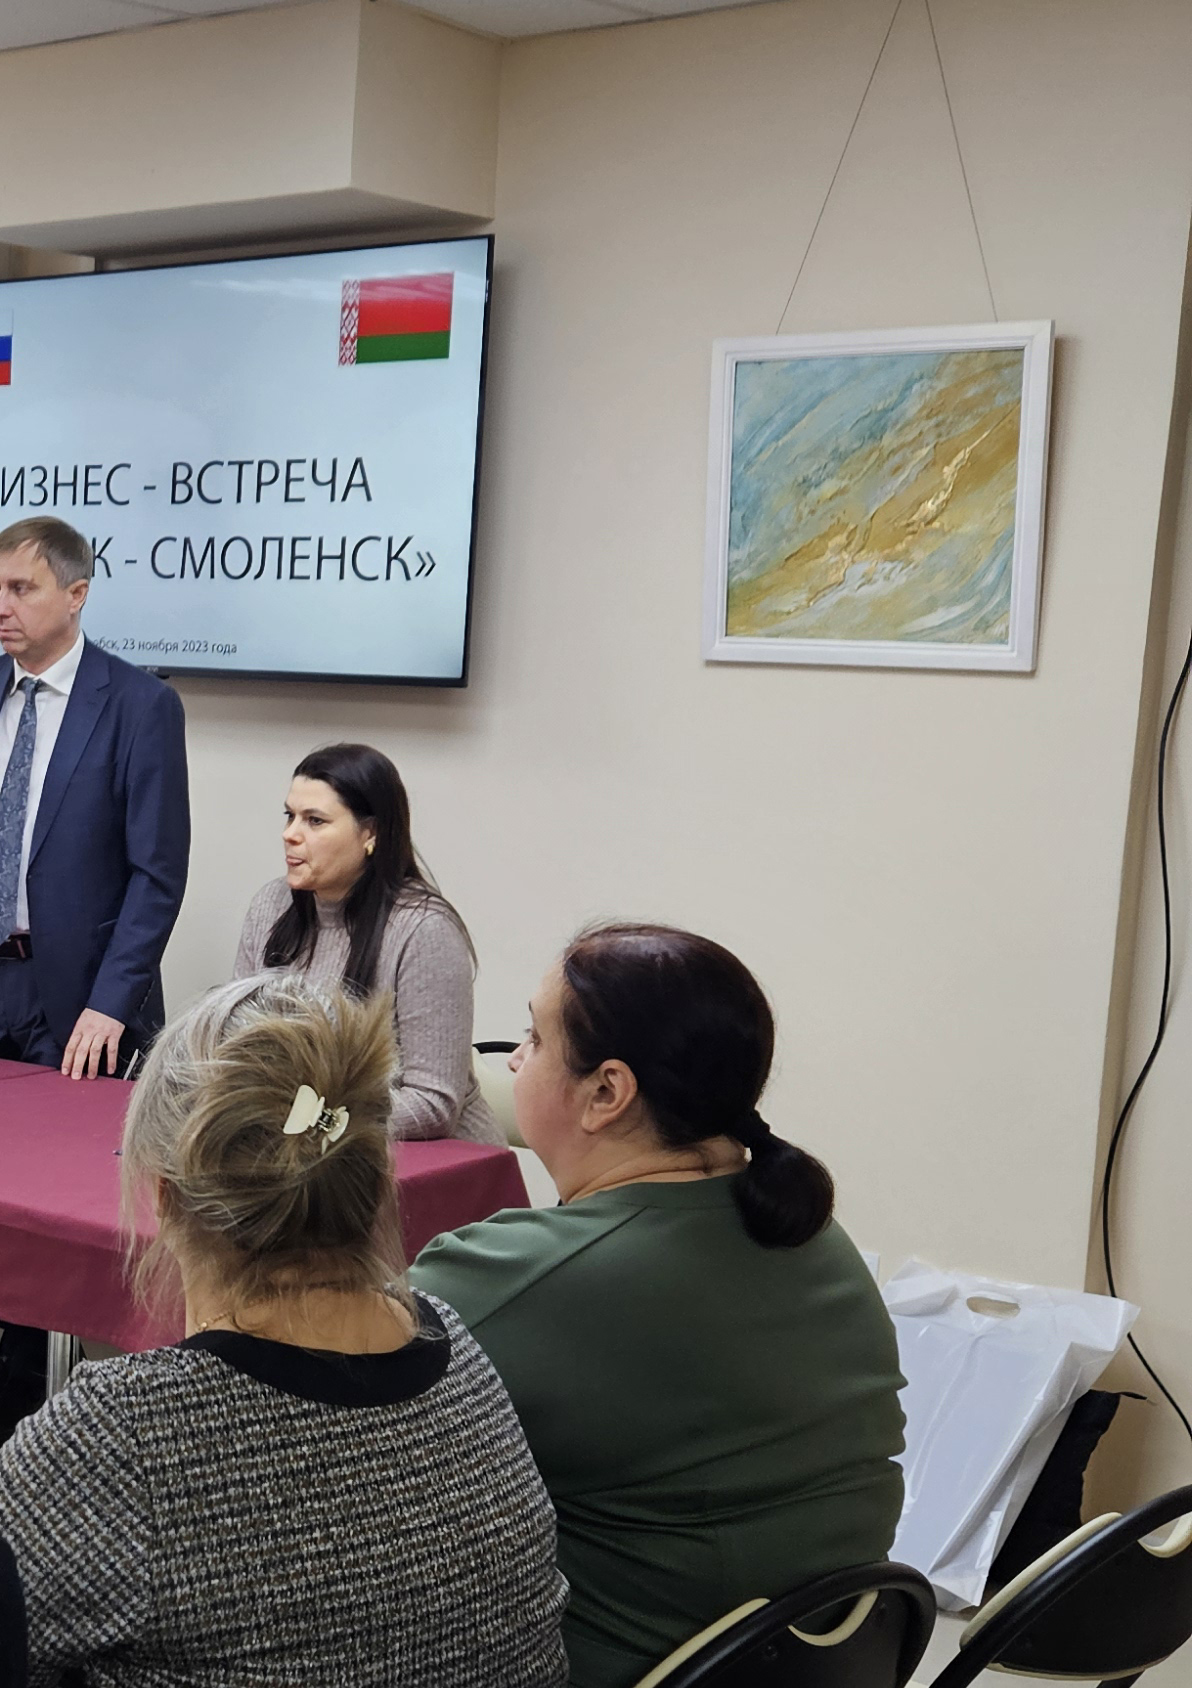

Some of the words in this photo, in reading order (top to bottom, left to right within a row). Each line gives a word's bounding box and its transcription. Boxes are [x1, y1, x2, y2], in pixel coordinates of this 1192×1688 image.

[170, 456, 374, 505] ВСТРЕЧА
[150, 535, 437, 582] СМОЛЕНСК»
[122, 637, 136, 651] 23
[138, 638, 179, 654] ноября
[182, 639, 209, 653] 2023
[211, 642, 238, 656] года
